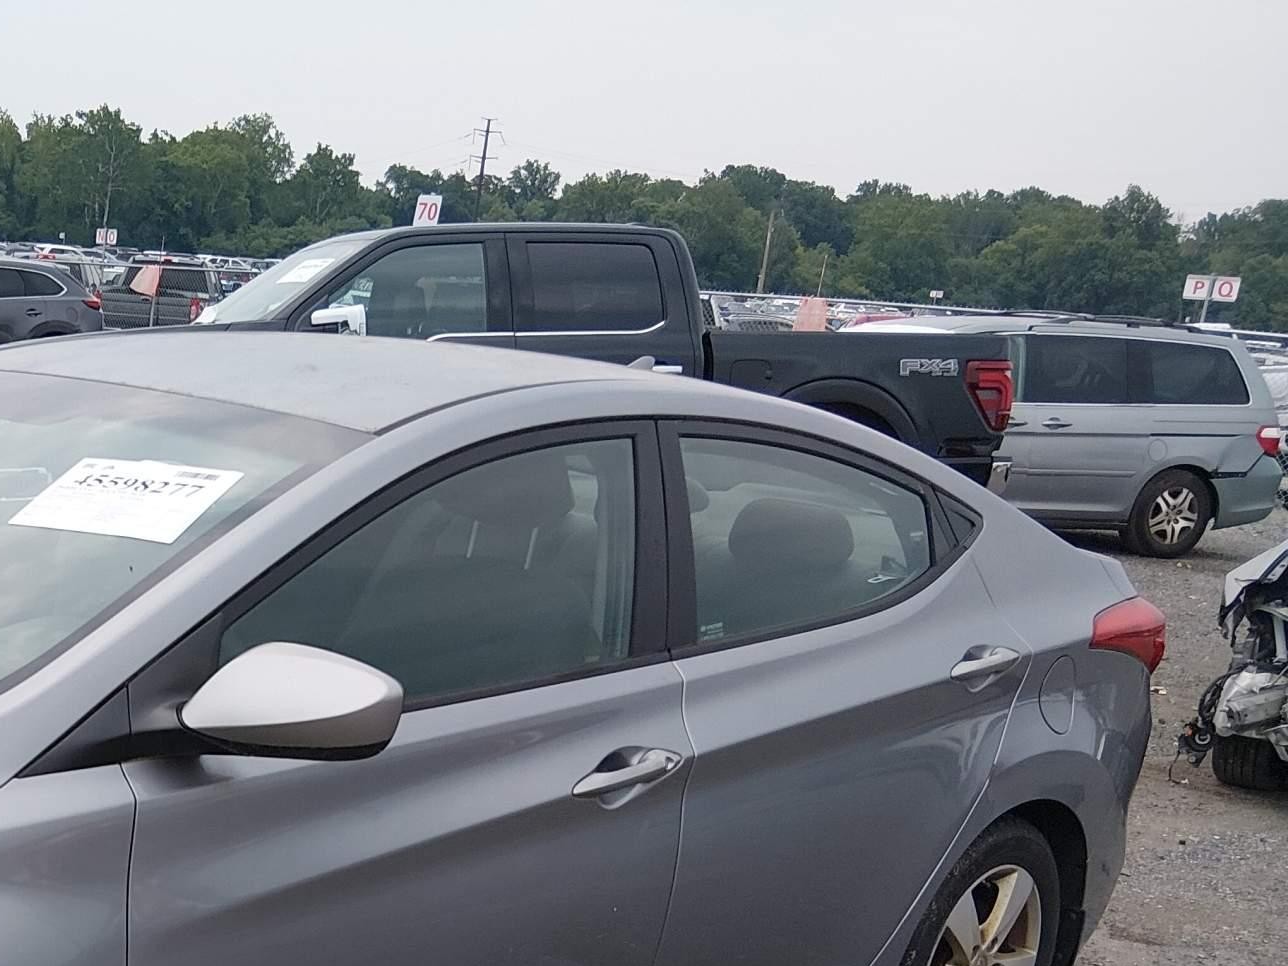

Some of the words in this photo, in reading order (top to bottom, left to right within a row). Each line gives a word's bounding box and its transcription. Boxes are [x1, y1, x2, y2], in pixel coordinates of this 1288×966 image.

[417, 202, 439, 221] 70
[1192, 280, 1205, 295] P
[1218, 280, 1234, 298] Q
[899, 358, 959, 377] FX4
[73, 474, 205, 498] 45598277
